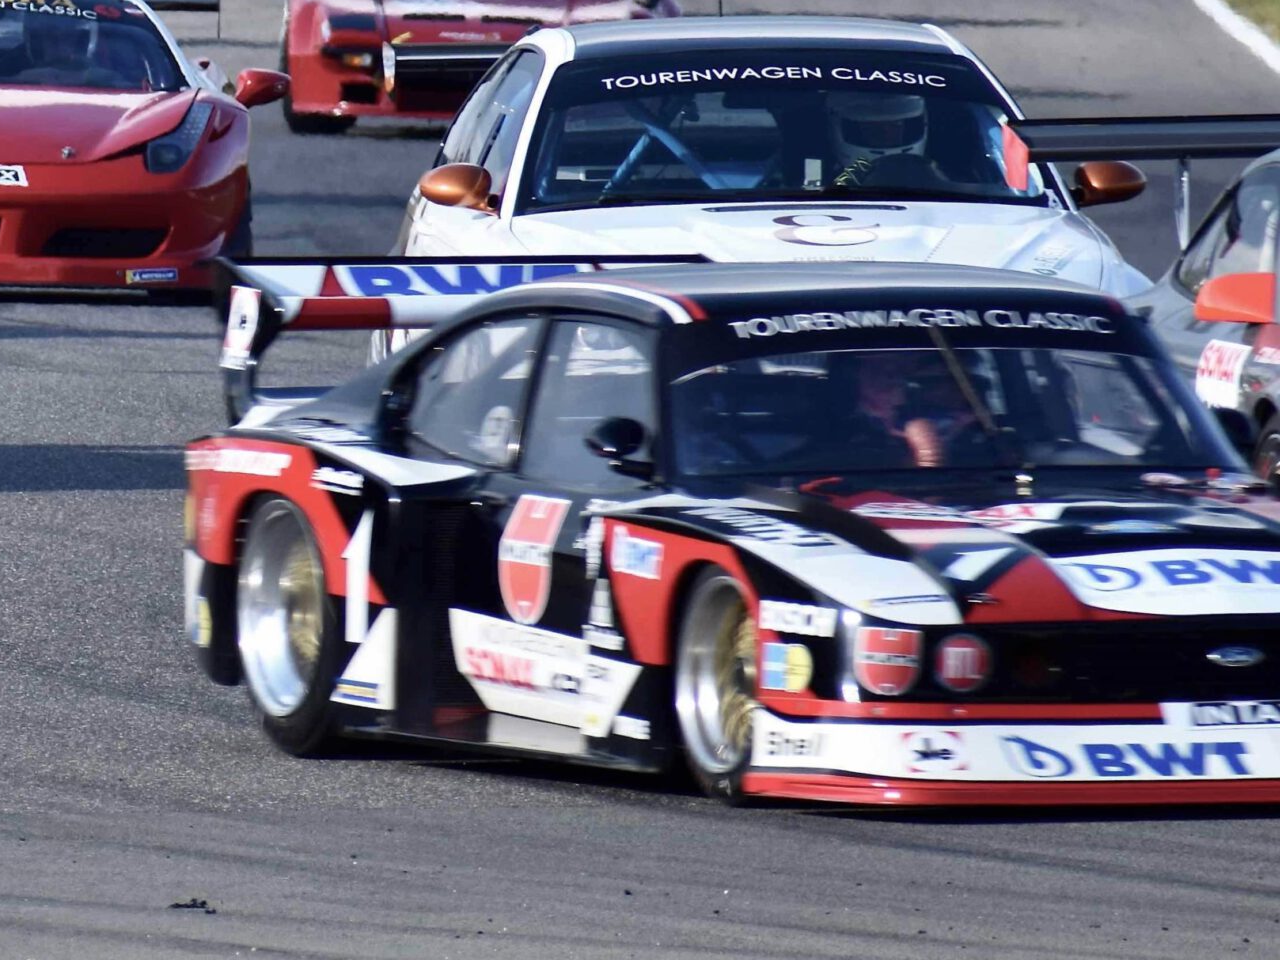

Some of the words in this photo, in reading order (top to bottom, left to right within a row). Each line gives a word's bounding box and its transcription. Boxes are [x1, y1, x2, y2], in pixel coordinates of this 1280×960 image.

[11, 1, 98, 20] CLASSIC
[601, 66, 823, 91] TOURENWAGEN
[830, 67, 947, 88] CLASSIC
[727, 308, 983, 340] TOURENWAGEN
[983, 309, 1117, 335] CLASSIC
[1082, 742, 1251, 777] BWT
